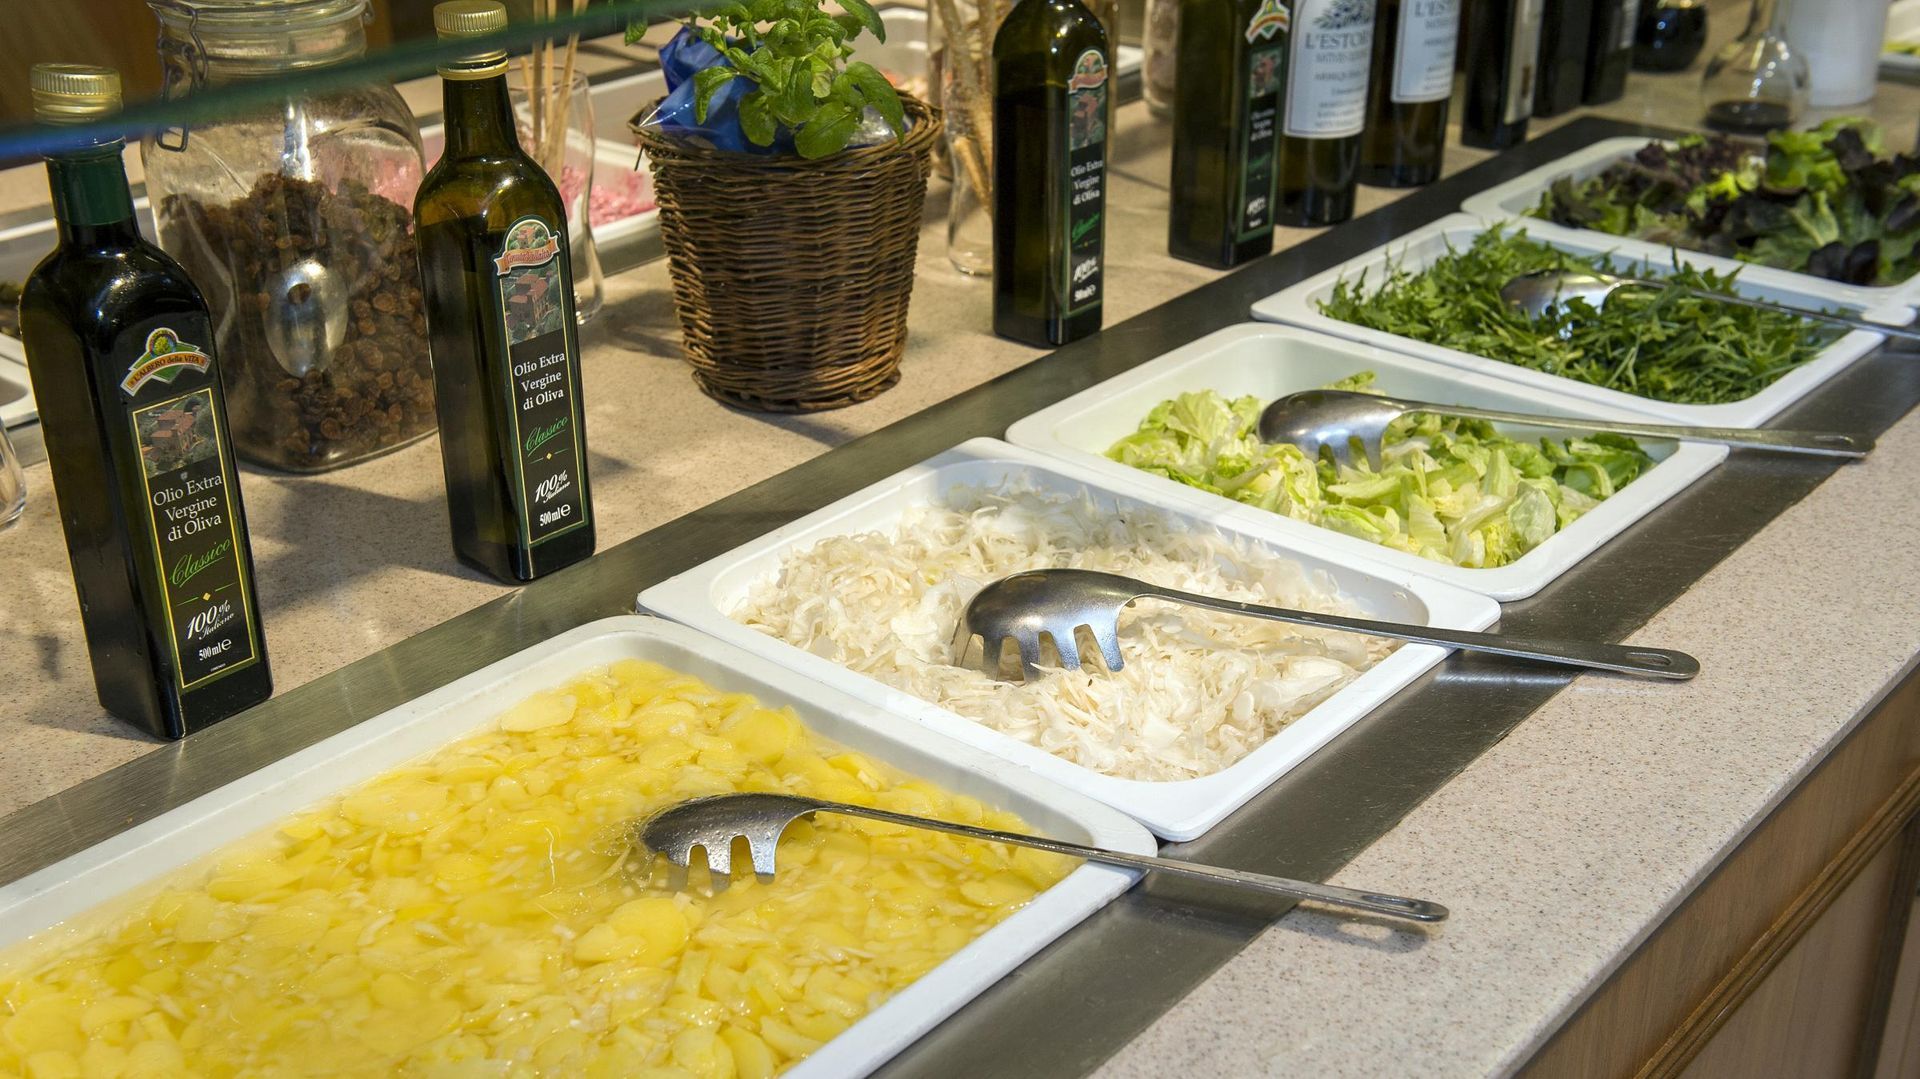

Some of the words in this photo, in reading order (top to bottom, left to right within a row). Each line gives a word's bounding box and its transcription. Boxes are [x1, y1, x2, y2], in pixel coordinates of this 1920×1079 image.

[133, 358, 166, 382] L'ALBERO
[184, 353, 200, 364] VITA
[514, 361, 537, 377] Olio
[538, 352, 566, 369] Extra
[521, 371, 562, 392] Vergine
[523, 397, 534, 411] di
[535, 389, 564, 406] Oliva
[526, 416, 568, 452] Classico
[153, 488, 184, 506] Olio
[186, 475, 222, 496] Extra
[534, 469, 568, 503] 100%
[165, 496, 217, 521] Vergine
[168, 525, 182, 542] di
[184, 514, 222, 535] Oliva
[171, 539, 231, 586] Classico
[187, 600, 231, 640] 100%
